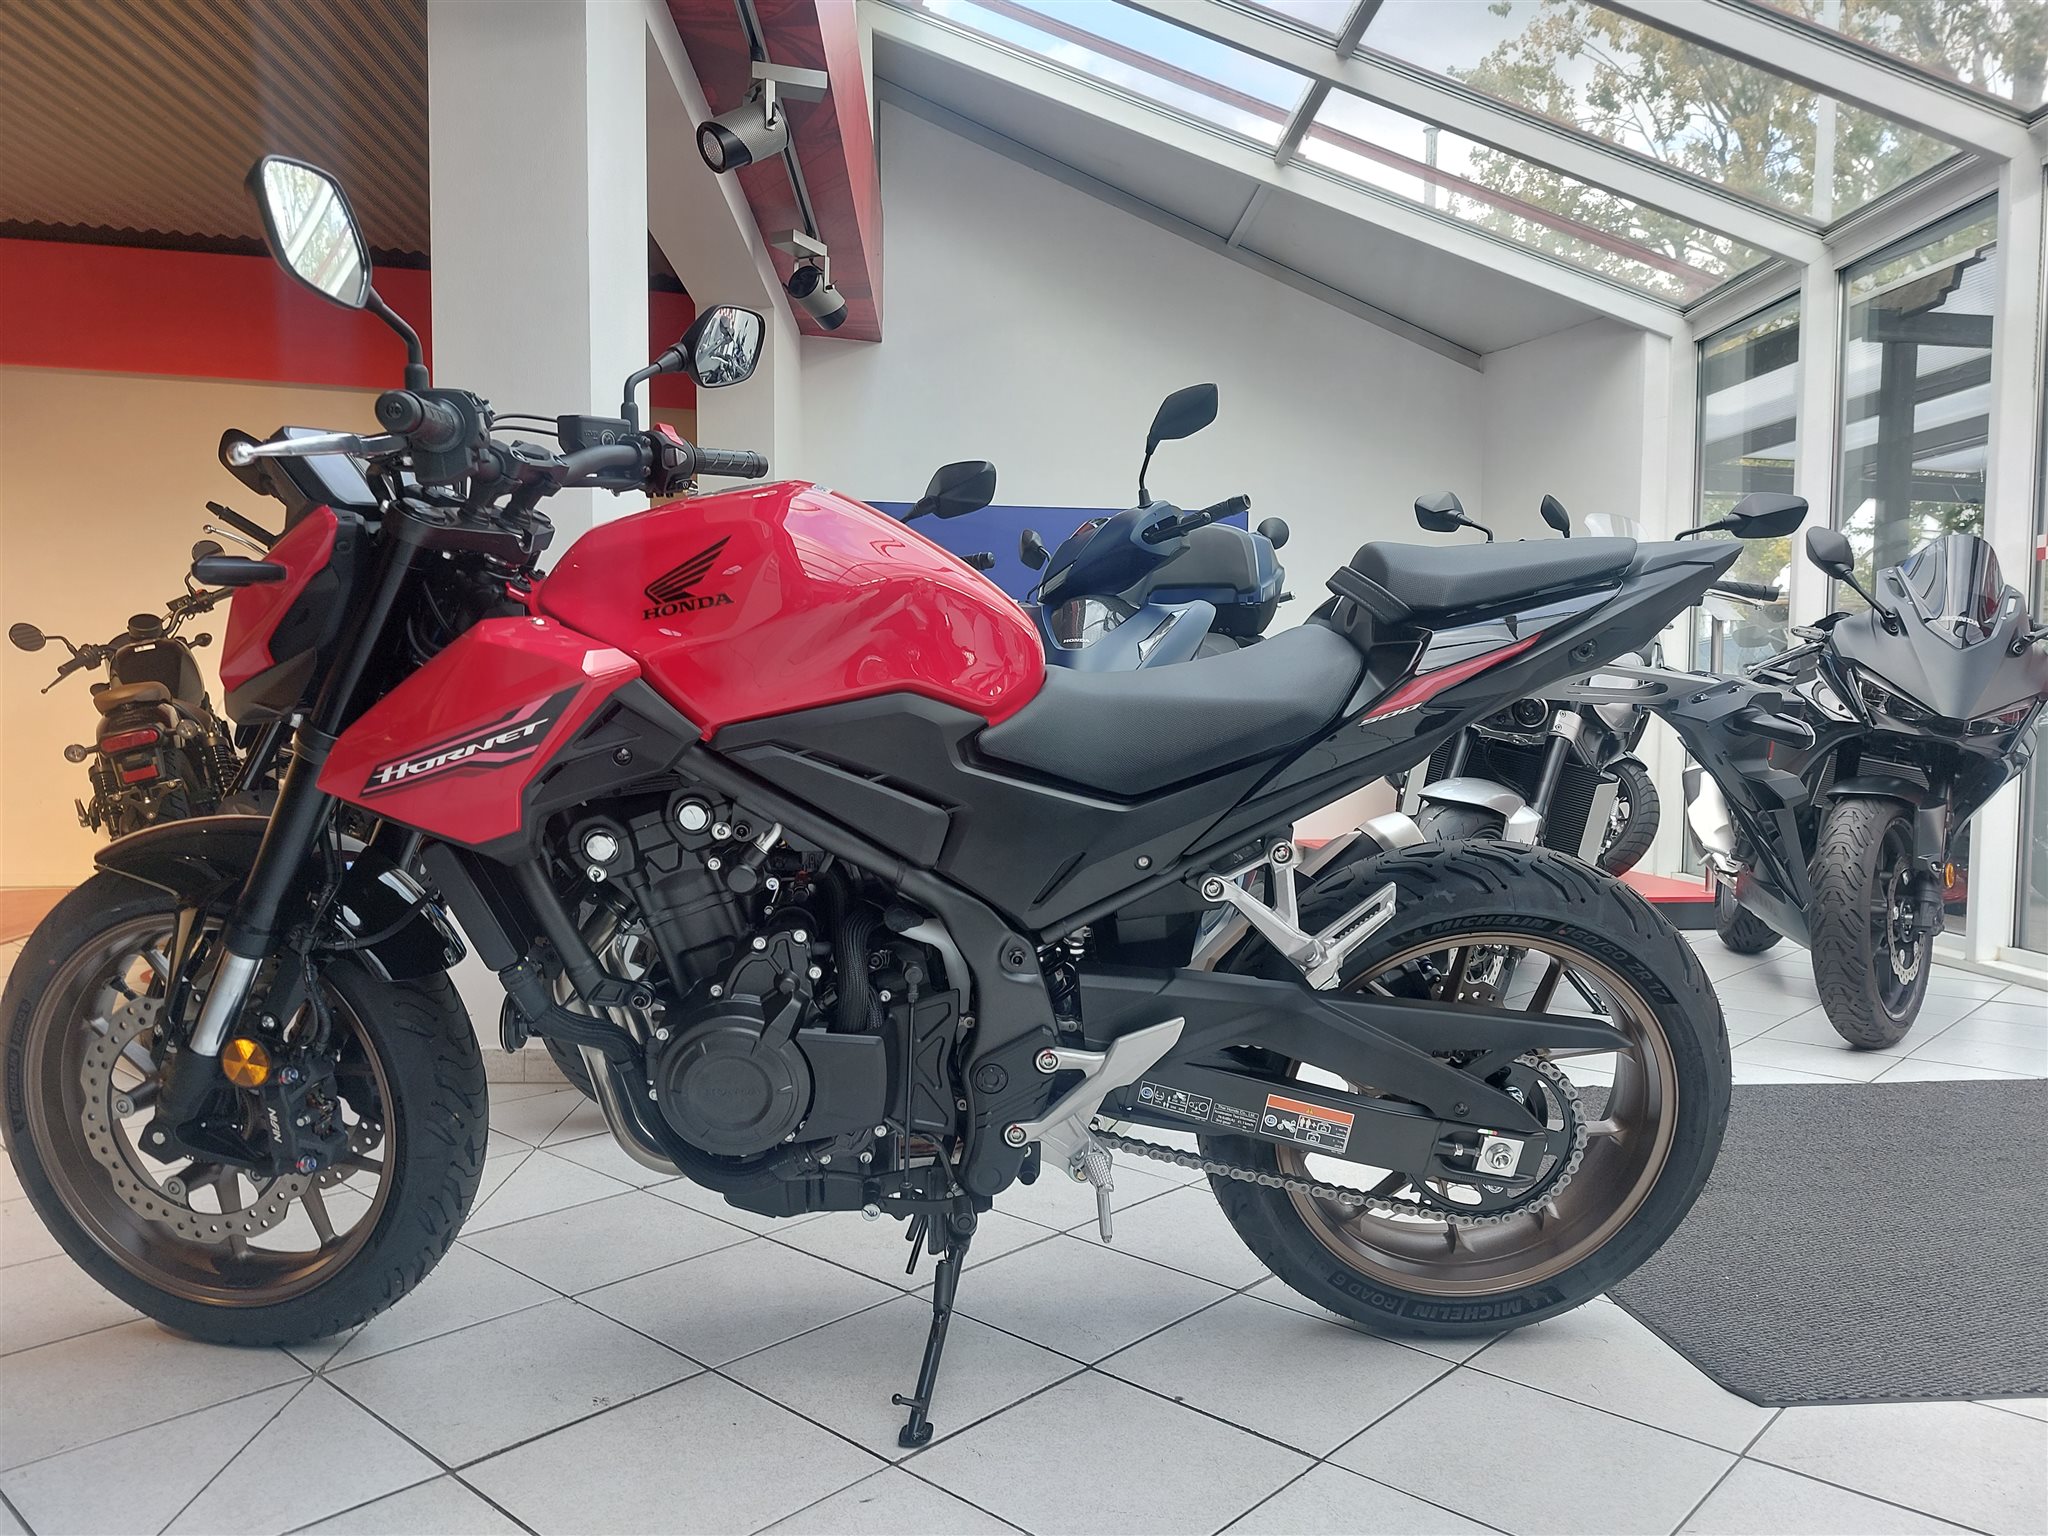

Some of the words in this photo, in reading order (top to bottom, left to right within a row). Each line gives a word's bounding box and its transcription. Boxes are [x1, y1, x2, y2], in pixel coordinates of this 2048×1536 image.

[643, 592, 735, 620] HONDA
[371, 717, 549, 784] HORNET
[1430, 914, 1552, 934] MICHELIN
[1564, 924, 1629, 961] 160/60
[1628, 962, 1653, 982] ZR
[1651, 982, 1671, 1000] 17
[1331, 1274, 1345, 1285] 6
[1347, 1284, 1397, 1310] ROAD
[1413, 1298, 1522, 1321] MICHELIN
